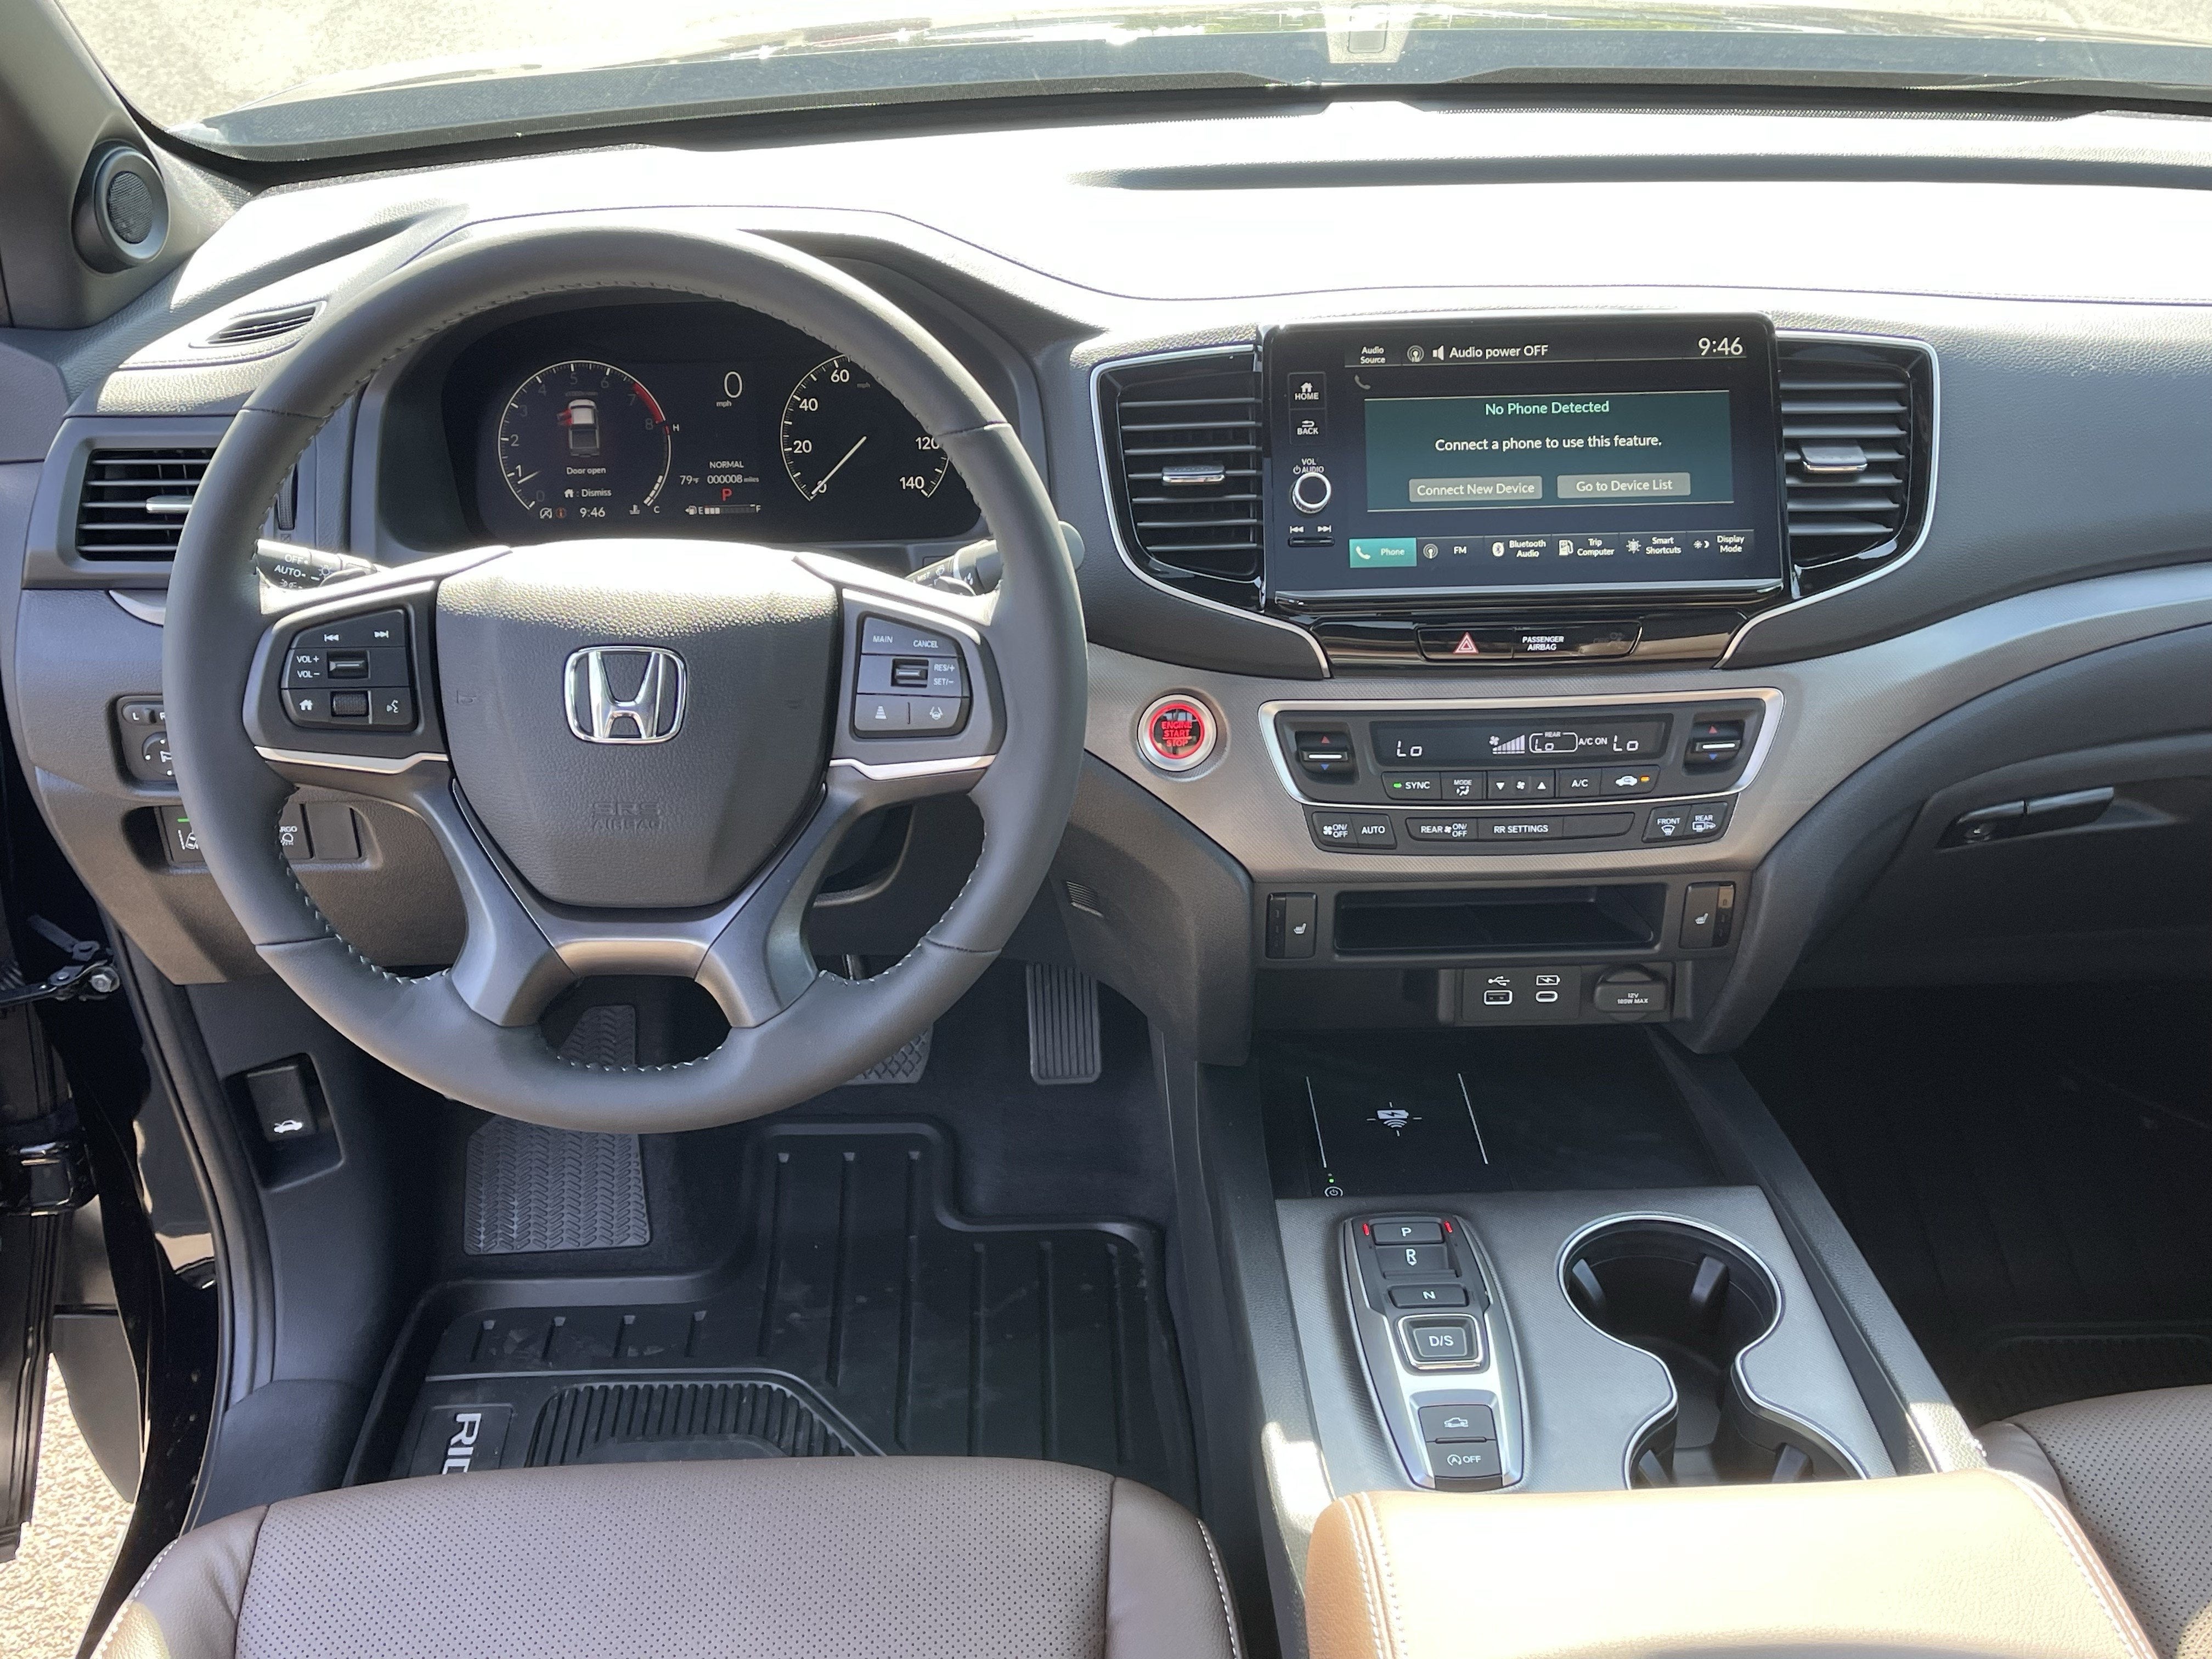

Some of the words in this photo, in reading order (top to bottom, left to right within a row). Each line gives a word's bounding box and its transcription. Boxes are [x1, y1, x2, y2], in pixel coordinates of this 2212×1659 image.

[1361, 346, 1384, 356] Audio
[1698, 337, 1743, 356] 9:46
[1449, 346, 1483, 358] Audio
[1485, 348, 1521, 360] power
[1523, 345, 1549, 356] OFF
[1361, 356, 1386, 364] Source
[830, 369, 850, 383] 60
[724, 371, 742, 398] 0
[1294, 392, 1319, 401] HOME
[716, 400, 732, 408] mph
[799, 398, 819, 411] 40
[1485, 403, 1504, 415] No
[1507, 402, 1548, 415] Phone
[1551, 400, 1610, 414] Detected
[1297, 427, 1319, 436] BACK
[511, 435, 520, 447] 2
[1435, 438, 1488, 452] Connect
[1491, 441, 1499, 450] a
[1502, 437, 1542, 453] phone
[1545, 437, 1559, 448] to
[1562, 438, 1584, 448] use
[1587, 435, 1611, 448] this
[1613, 434, 1662, 447] feature.
[793, 439, 812, 454] 20
[516, 465, 522, 477] 1
[566, 467, 585, 475] Door
[588, 467, 606, 476] open
[707, 474, 743, 484] 000008
[900, 476, 924, 489] 140
[1417, 483, 1464, 496] Connect
[1467, 484, 1493, 495] New
[1496, 483, 1536, 495] Device
[1576, 481, 1593, 493] Go
[1595, 481, 1608, 492] to
[1611, 479, 1650, 492] Device
[1652, 479, 1673, 490] List
[582, 488, 612, 498] Dismiss
[722, 488, 732, 501] P
[579, 507, 606, 518] 9:46
[653, 505, 660, 514] C
[698, 506, 704, 515] E
[755, 505, 761, 513] F
[1509, 539, 1546, 548] Bluetooth
[1588, 538, 1602, 548] Trip
[1652, 537, 1674, 545] Smart
[1717, 535, 1745, 545] Display
[1380, 547, 1406, 556] Phone
[1453, 546, 1467, 555] FM
[1516, 549, 1539, 558] Audio
[1577, 548, 1615, 557] Computer
[1646, 546, 1681, 555] Shortcuts
[1720, 545, 1742, 553] Mode
[285, 554, 304, 565] OFF
[274, 565, 301, 578] AUTO
[913, 640, 939, 648] CANCEL
[132, 712, 139, 720] L
[1161, 721, 1192, 729] ENGINE
[1405, 781, 1431, 790] SYNC
[1571, 778, 1589, 788] A/C
[1657, 817, 1681, 826] FRONT
[1361, 826, 1385, 834] AUTO
[1420, 825, 1443, 834] REAR
[1494, 825, 1506, 833] RR
[1508, 825, 1549, 834] SETTINGS
[1401, 1227, 1412, 1237] P
[1406, 1248, 1417, 1262] R
[1422, 1290, 1436, 1300] N
[1429, 1335, 1454, 1347] D/S
[1462, 1455, 1481, 1463] OFF
